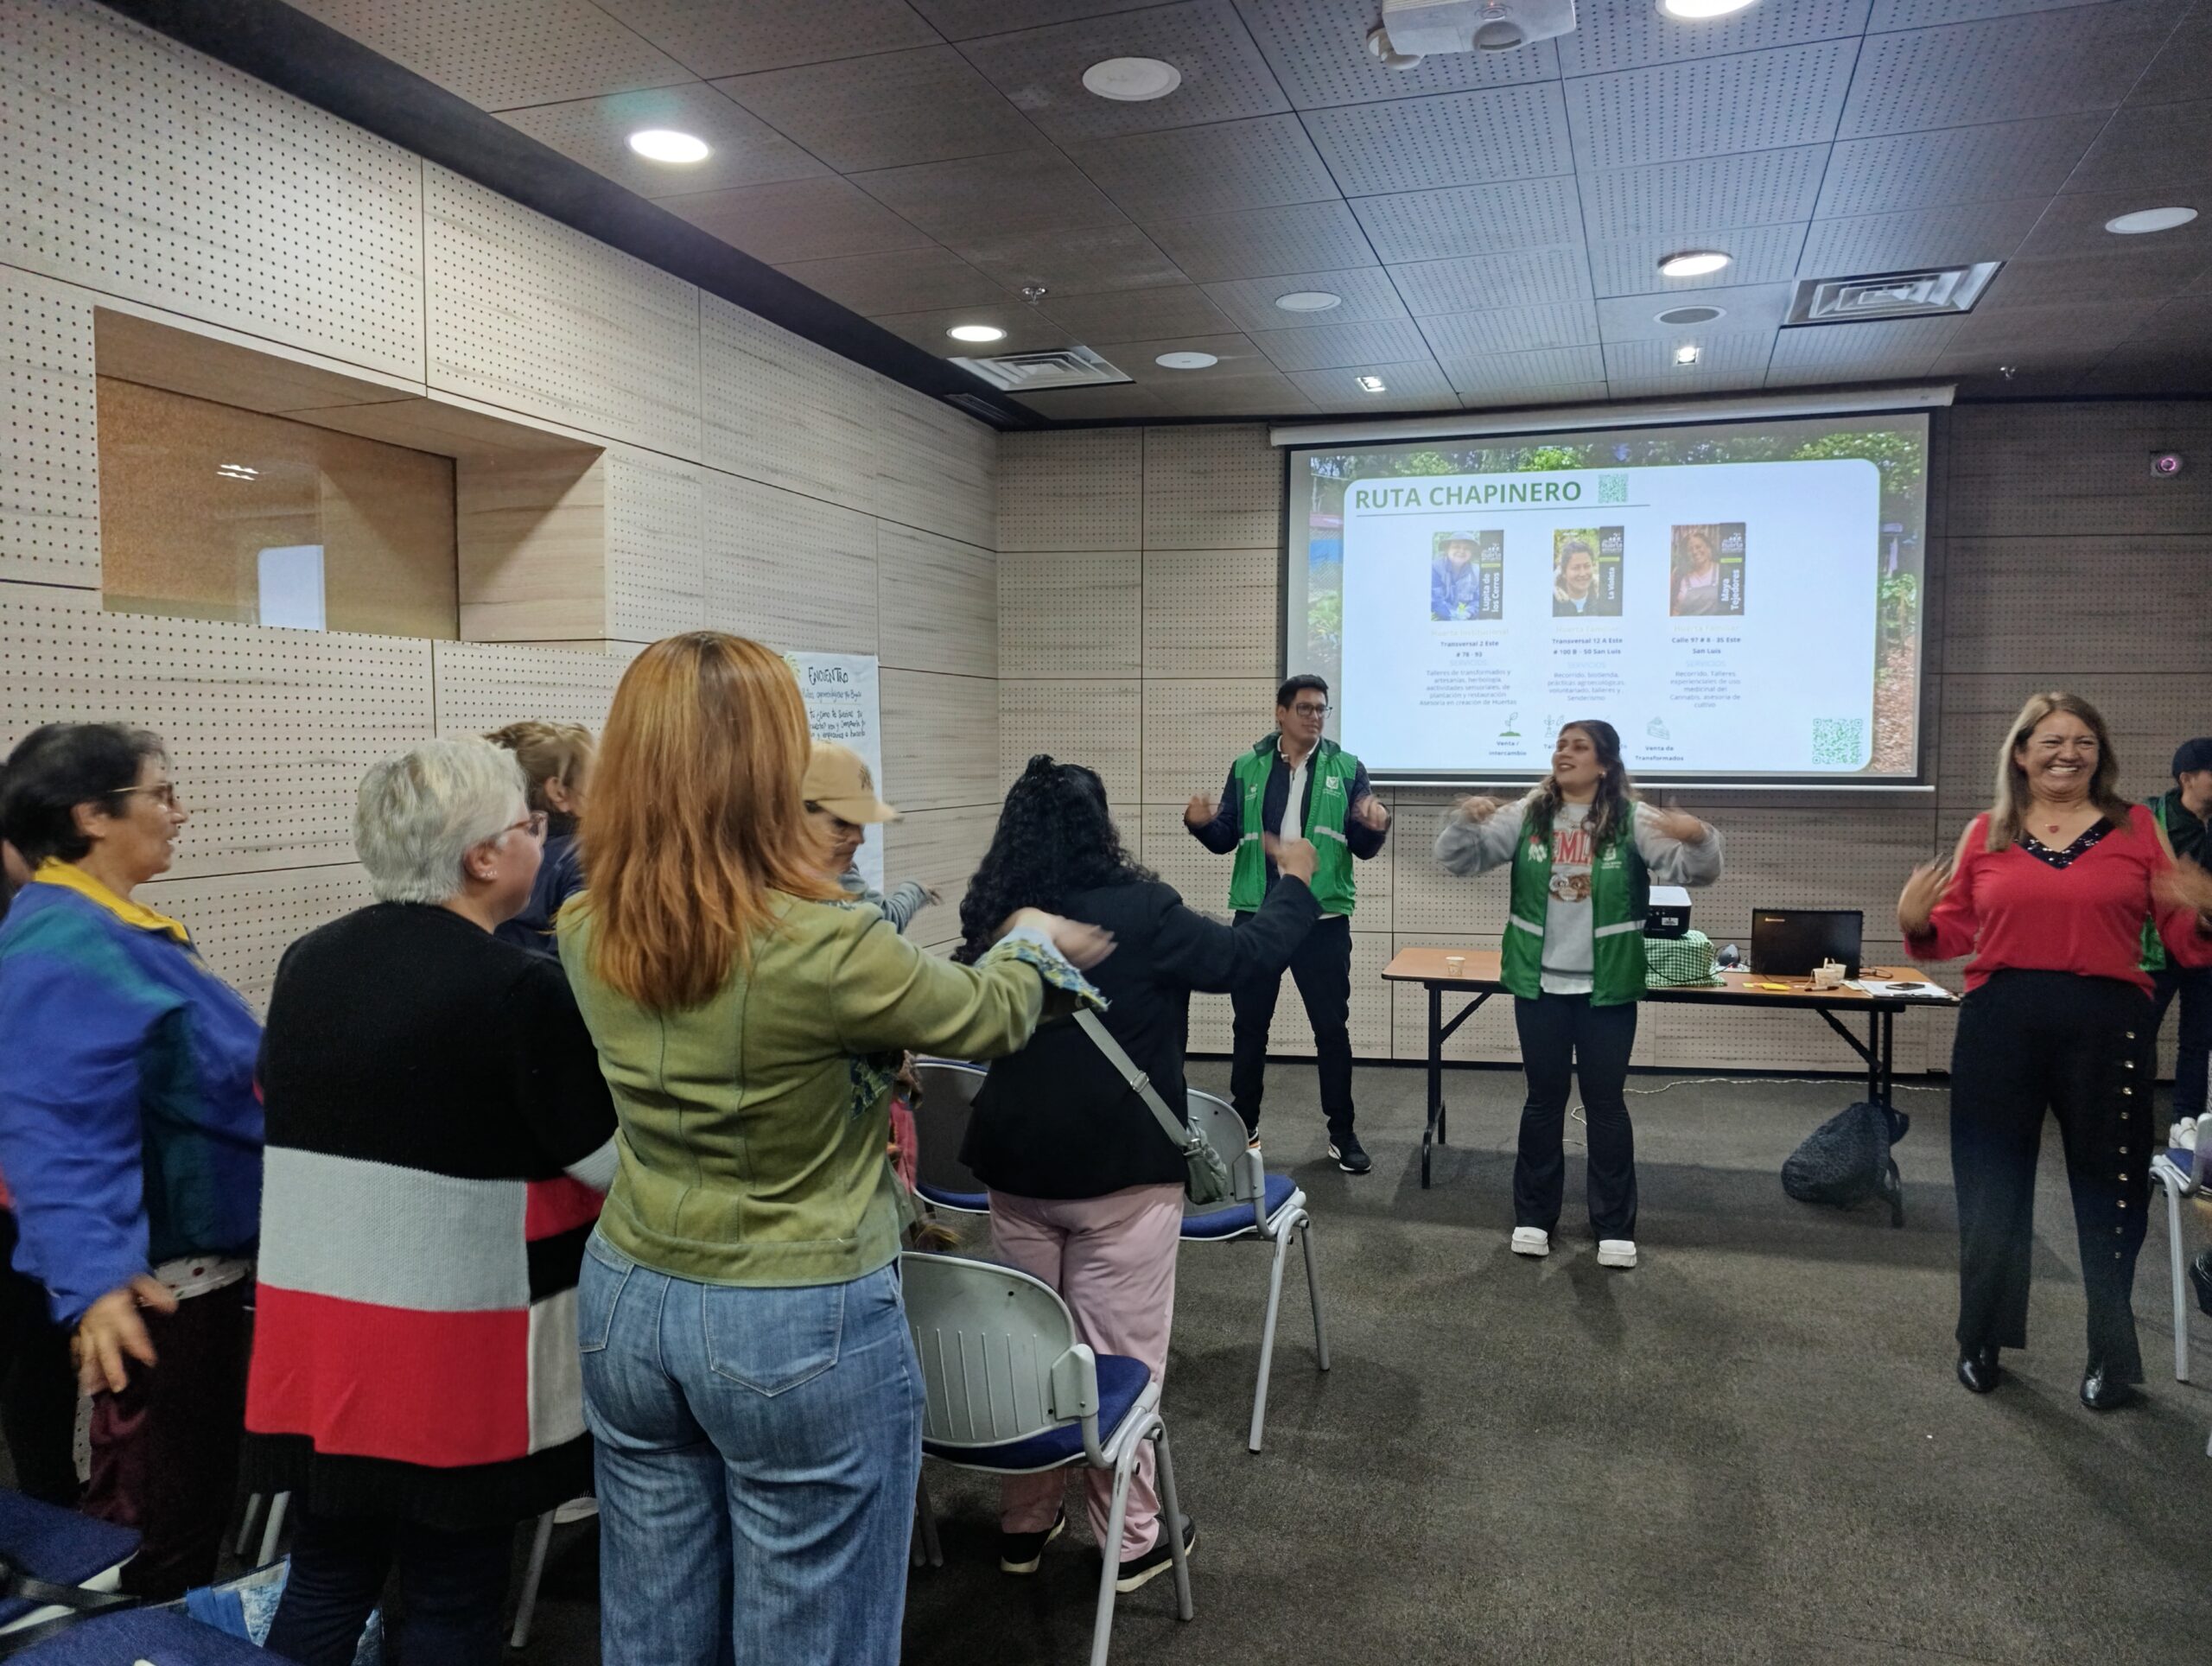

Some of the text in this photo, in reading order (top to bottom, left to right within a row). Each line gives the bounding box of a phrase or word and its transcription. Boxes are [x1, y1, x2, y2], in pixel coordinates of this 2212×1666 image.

[1356, 481, 1581, 509] RUTA CHAPINERO
[1482, 574, 1491, 611] Lupita de
[1608, 591, 1615, 601] La
[1721, 578, 1732, 601] Maya
[1731, 569, 1741, 610] Tejedores
[808, 667, 849, 685] ENCUENTRO
